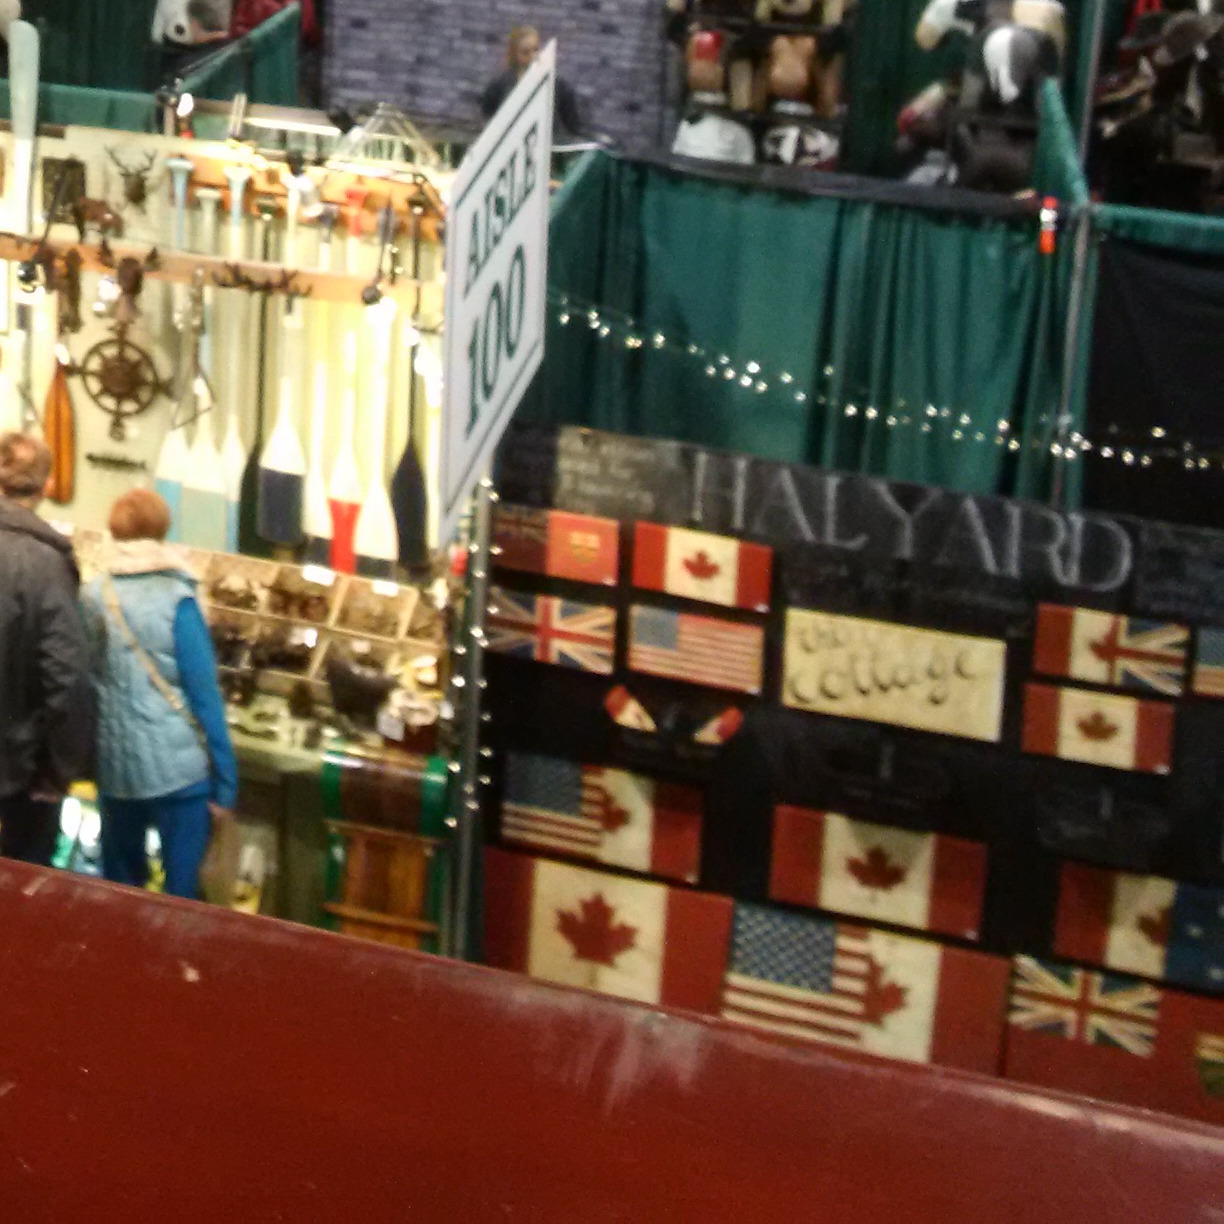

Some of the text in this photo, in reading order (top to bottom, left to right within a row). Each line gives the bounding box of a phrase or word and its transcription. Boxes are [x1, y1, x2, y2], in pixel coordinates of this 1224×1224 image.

[463, 119, 539, 300] AISLE
[465, 242, 526, 441] 100
[689, 449, 1134, 593] HALYARD
